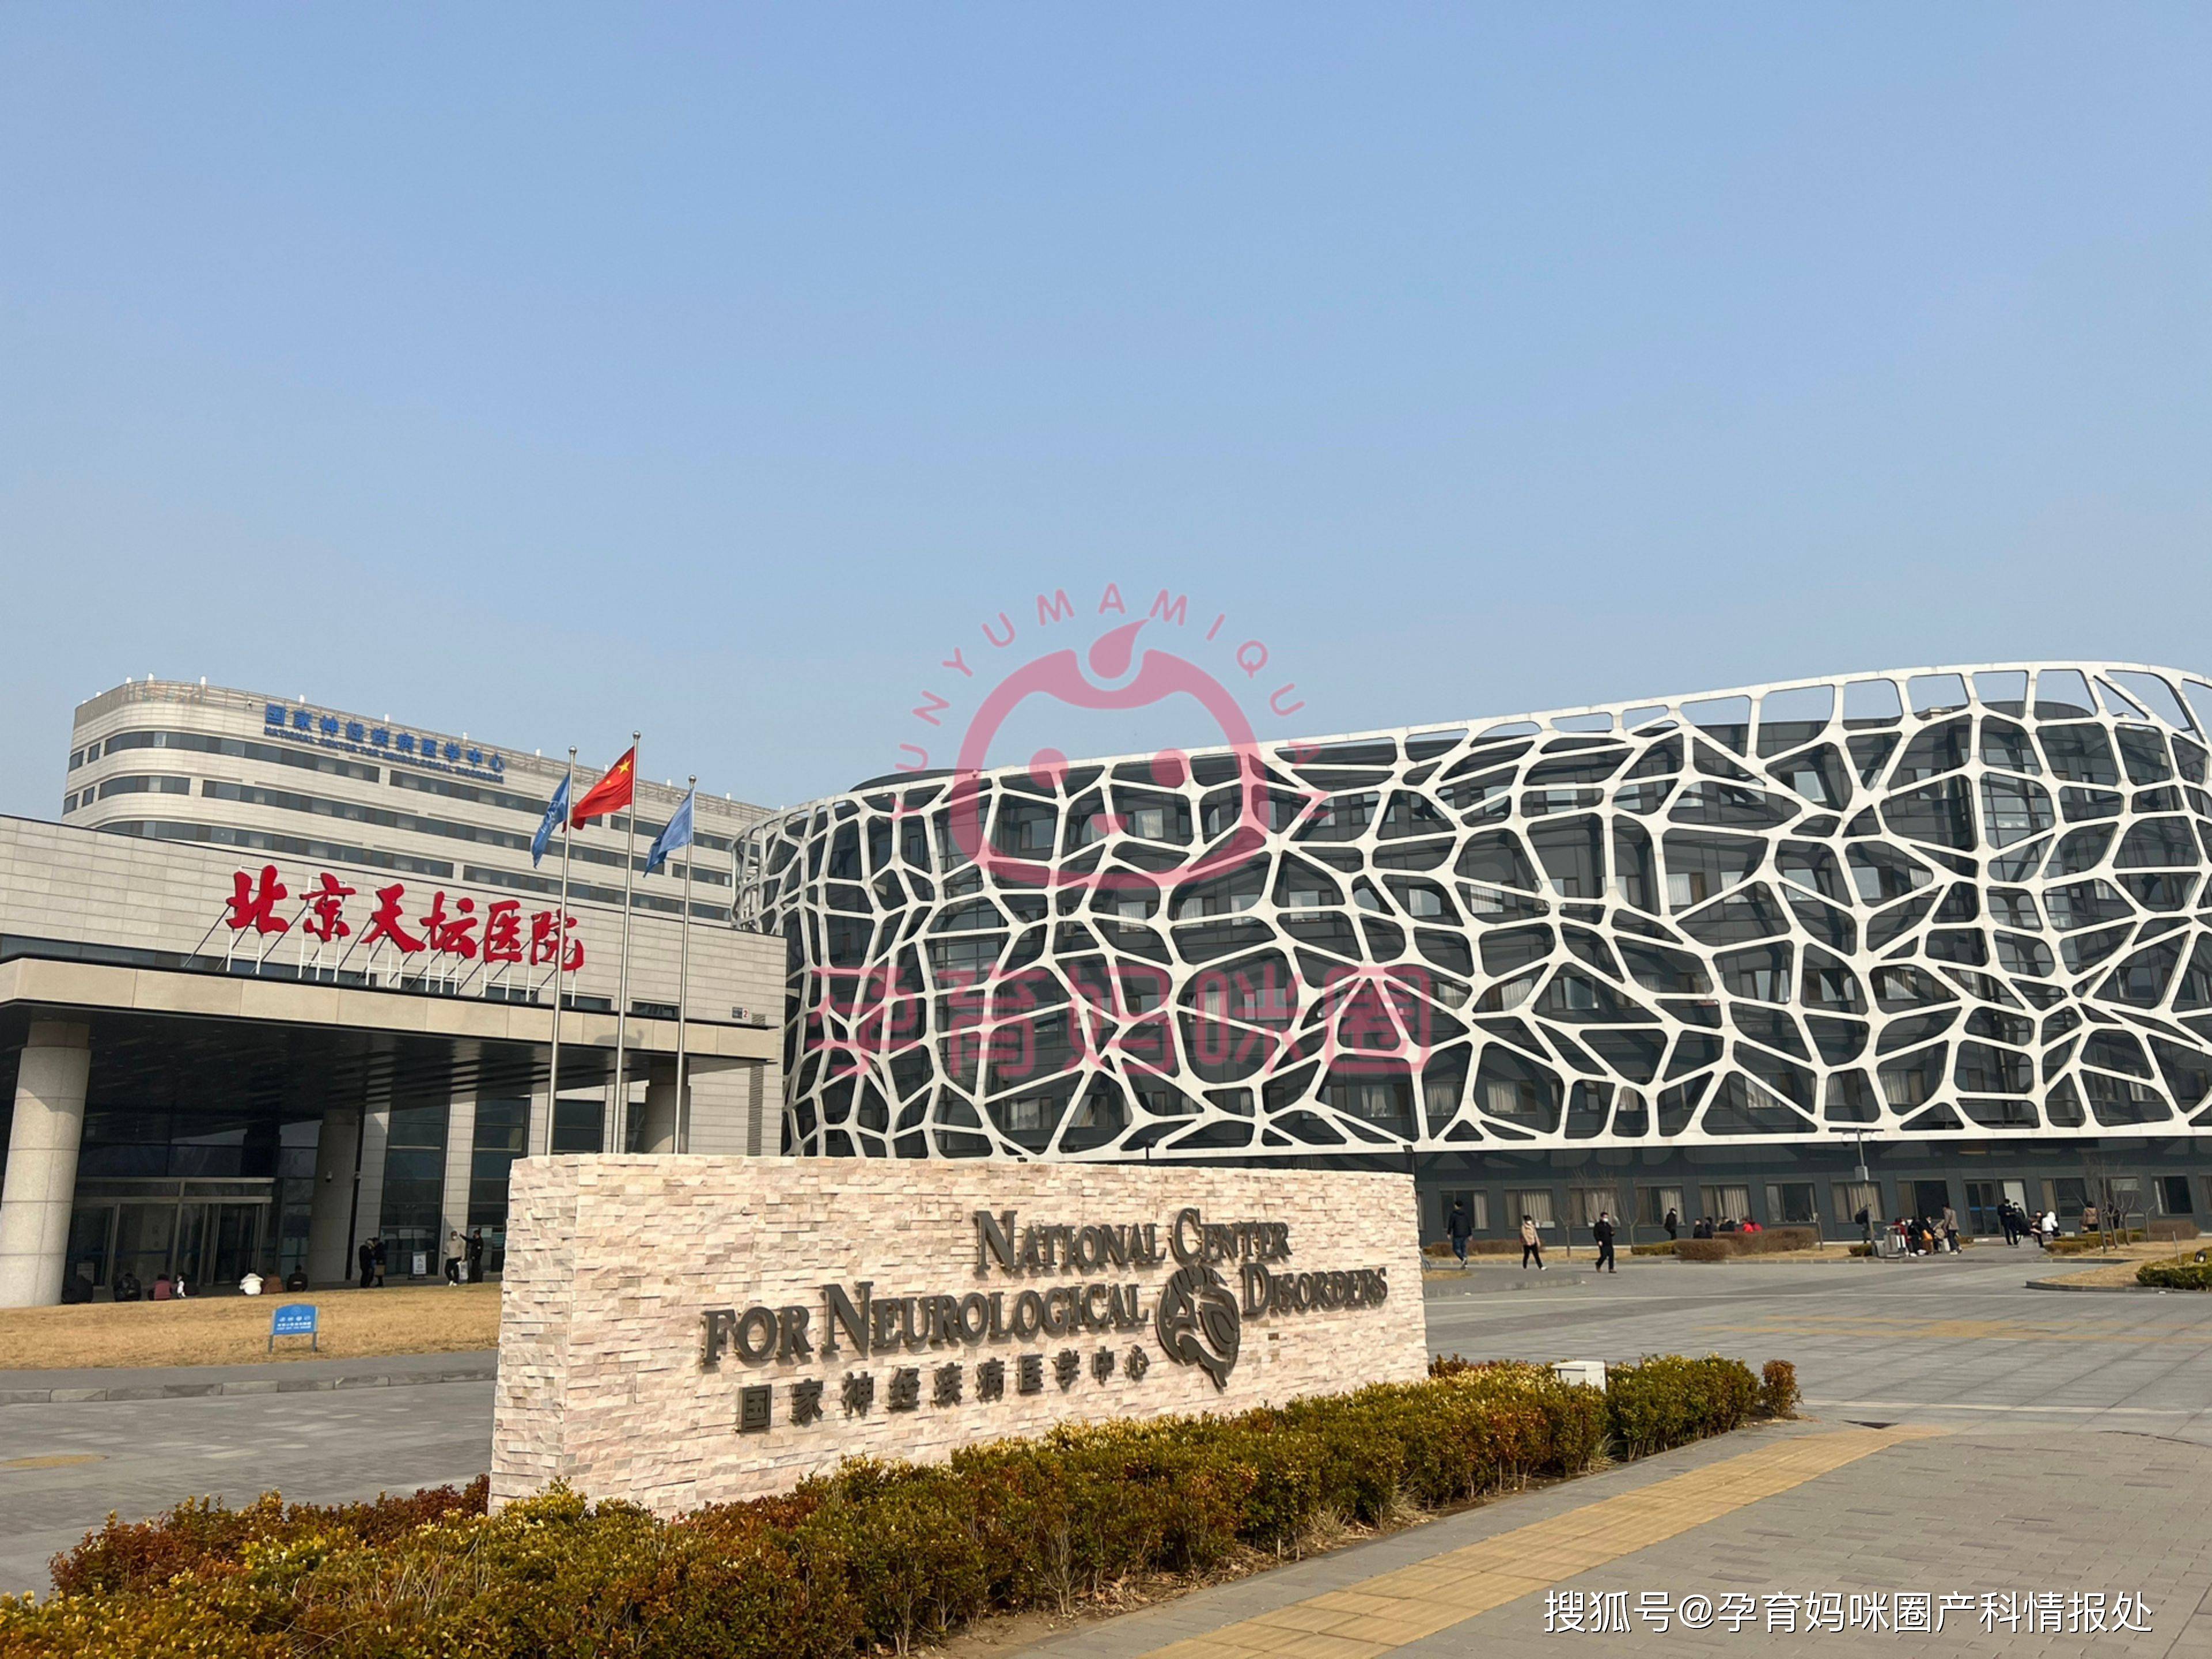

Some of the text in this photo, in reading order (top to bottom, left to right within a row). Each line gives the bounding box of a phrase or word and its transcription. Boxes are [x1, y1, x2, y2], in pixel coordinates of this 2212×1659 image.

[265, 703, 505, 772] 国家神经疾病医学中心
[225, 864, 585, 971] 北京天坛医院
[974, 1207, 1293, 1275] NATIONAL CENTER
[702, 1263, 1388, 1365] FOR NEUROLOGICAL DISORDERS
[736, 1344, 1150, 1433] 国家神经疾病医学中心
